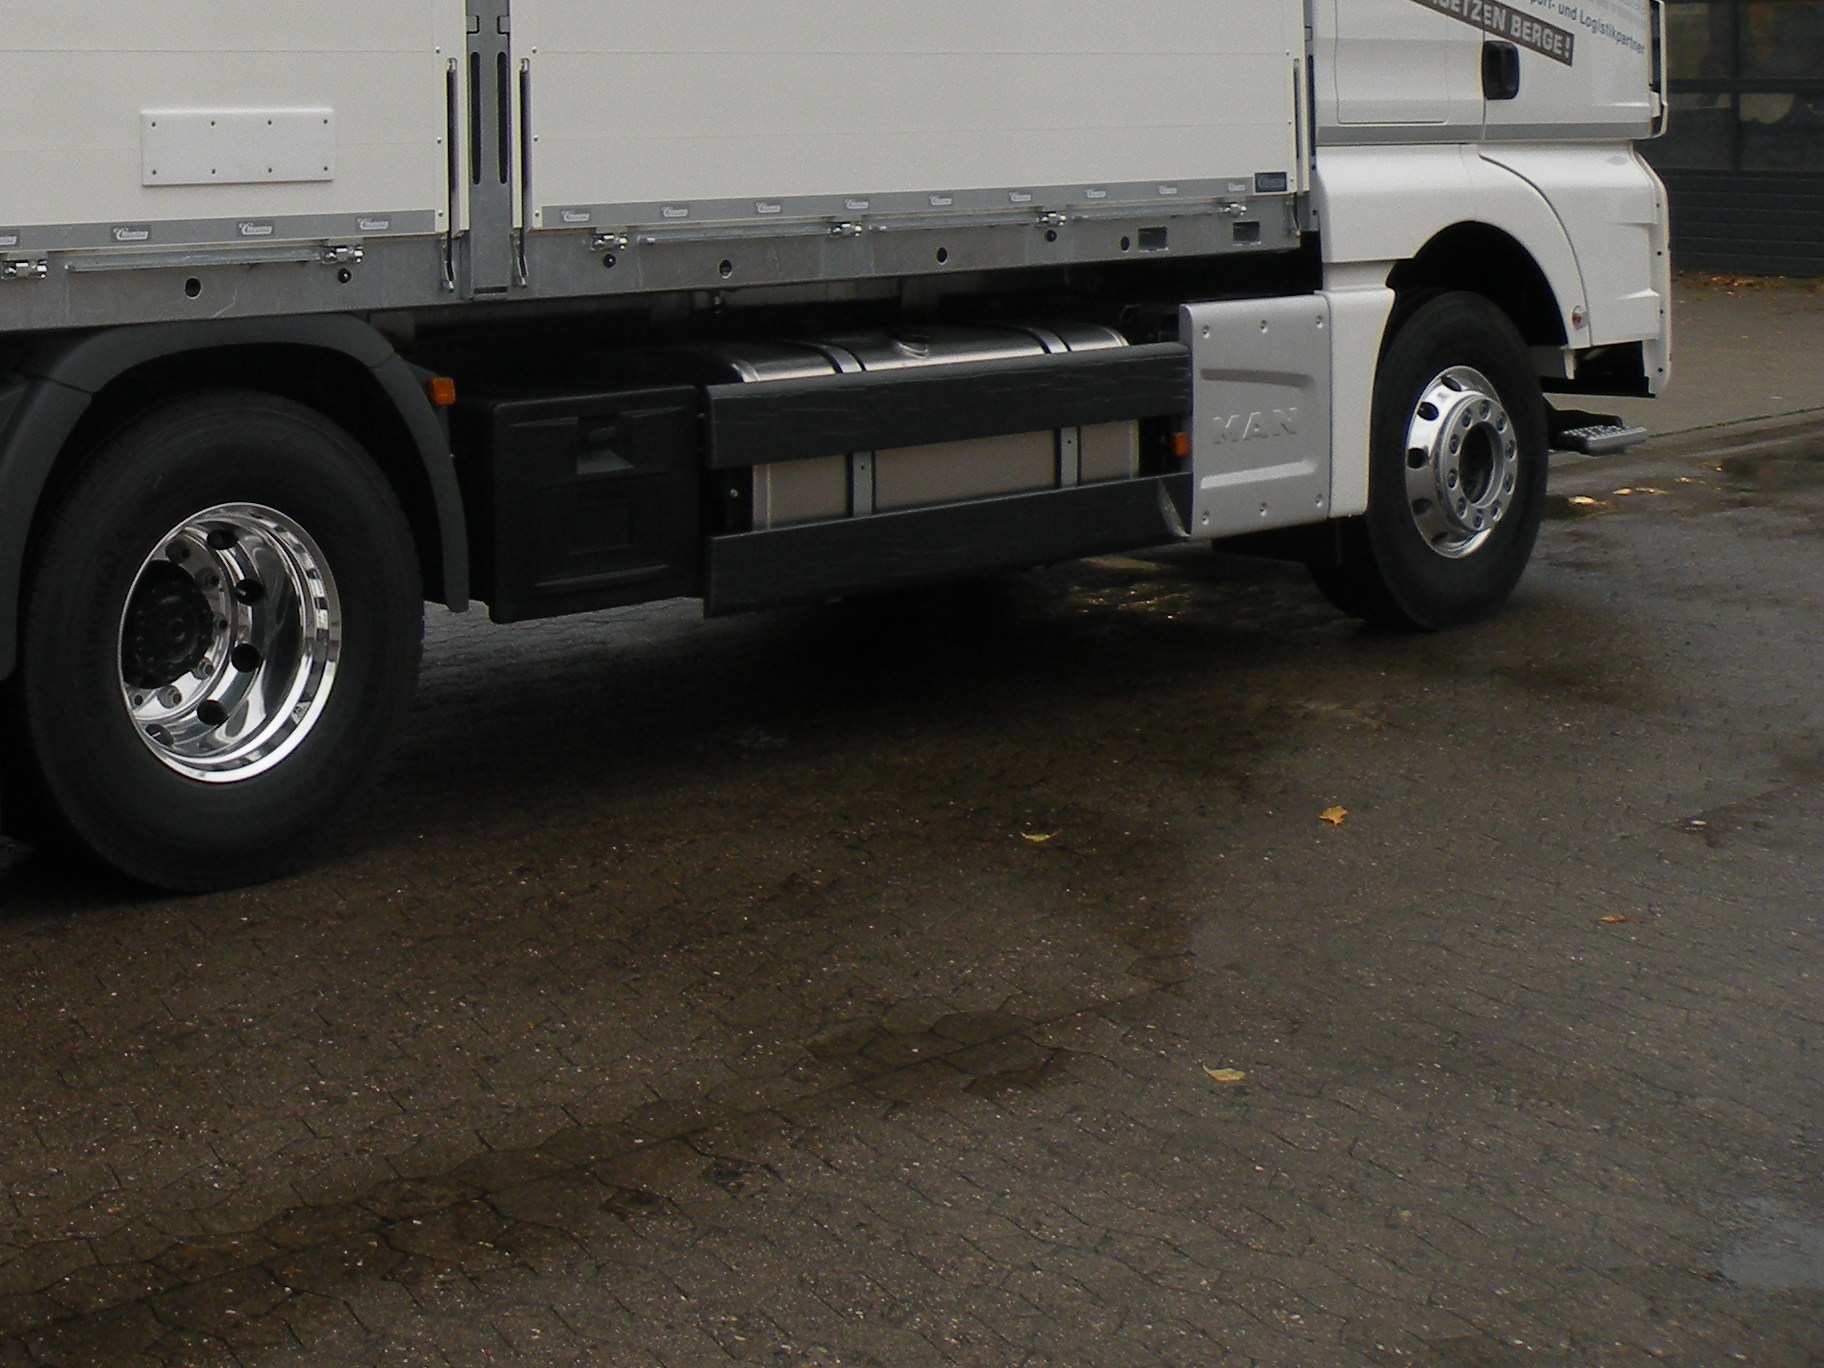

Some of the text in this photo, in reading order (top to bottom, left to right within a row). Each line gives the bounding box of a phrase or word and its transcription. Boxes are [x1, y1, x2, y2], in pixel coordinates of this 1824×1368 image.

[1558, 3, 1577, 21] und
[1580, 10, 1645, 54] Logistikpartner
[1212, 407, 1298, 445] MAN
